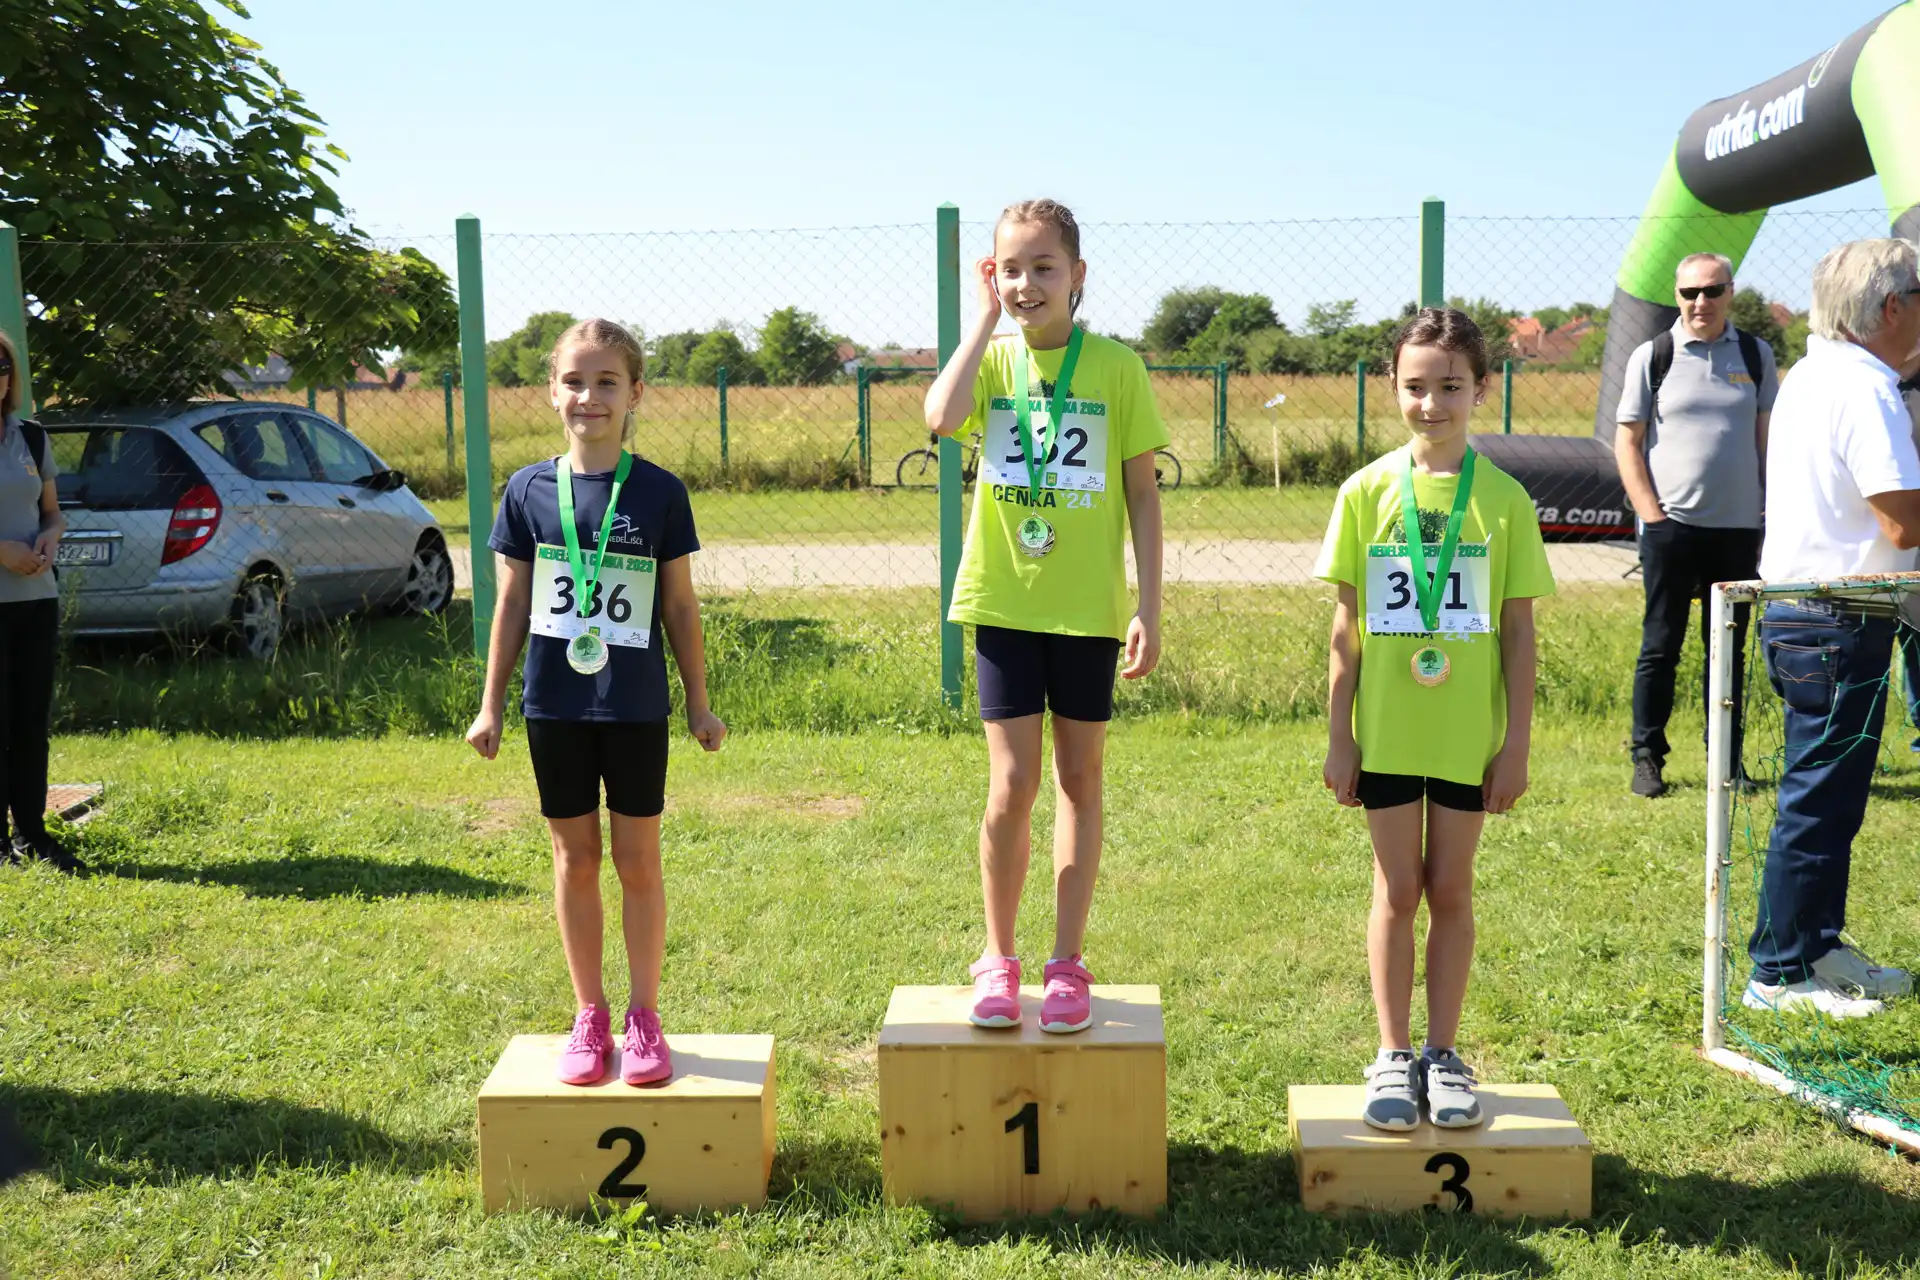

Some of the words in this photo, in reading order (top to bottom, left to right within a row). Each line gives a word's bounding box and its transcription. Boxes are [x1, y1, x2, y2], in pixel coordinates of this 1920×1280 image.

[596, 1126, 648, 1198] 2
[1004, 1102, 1040, 1175] 1
[1423, 1151, 1474, 1214] 3
